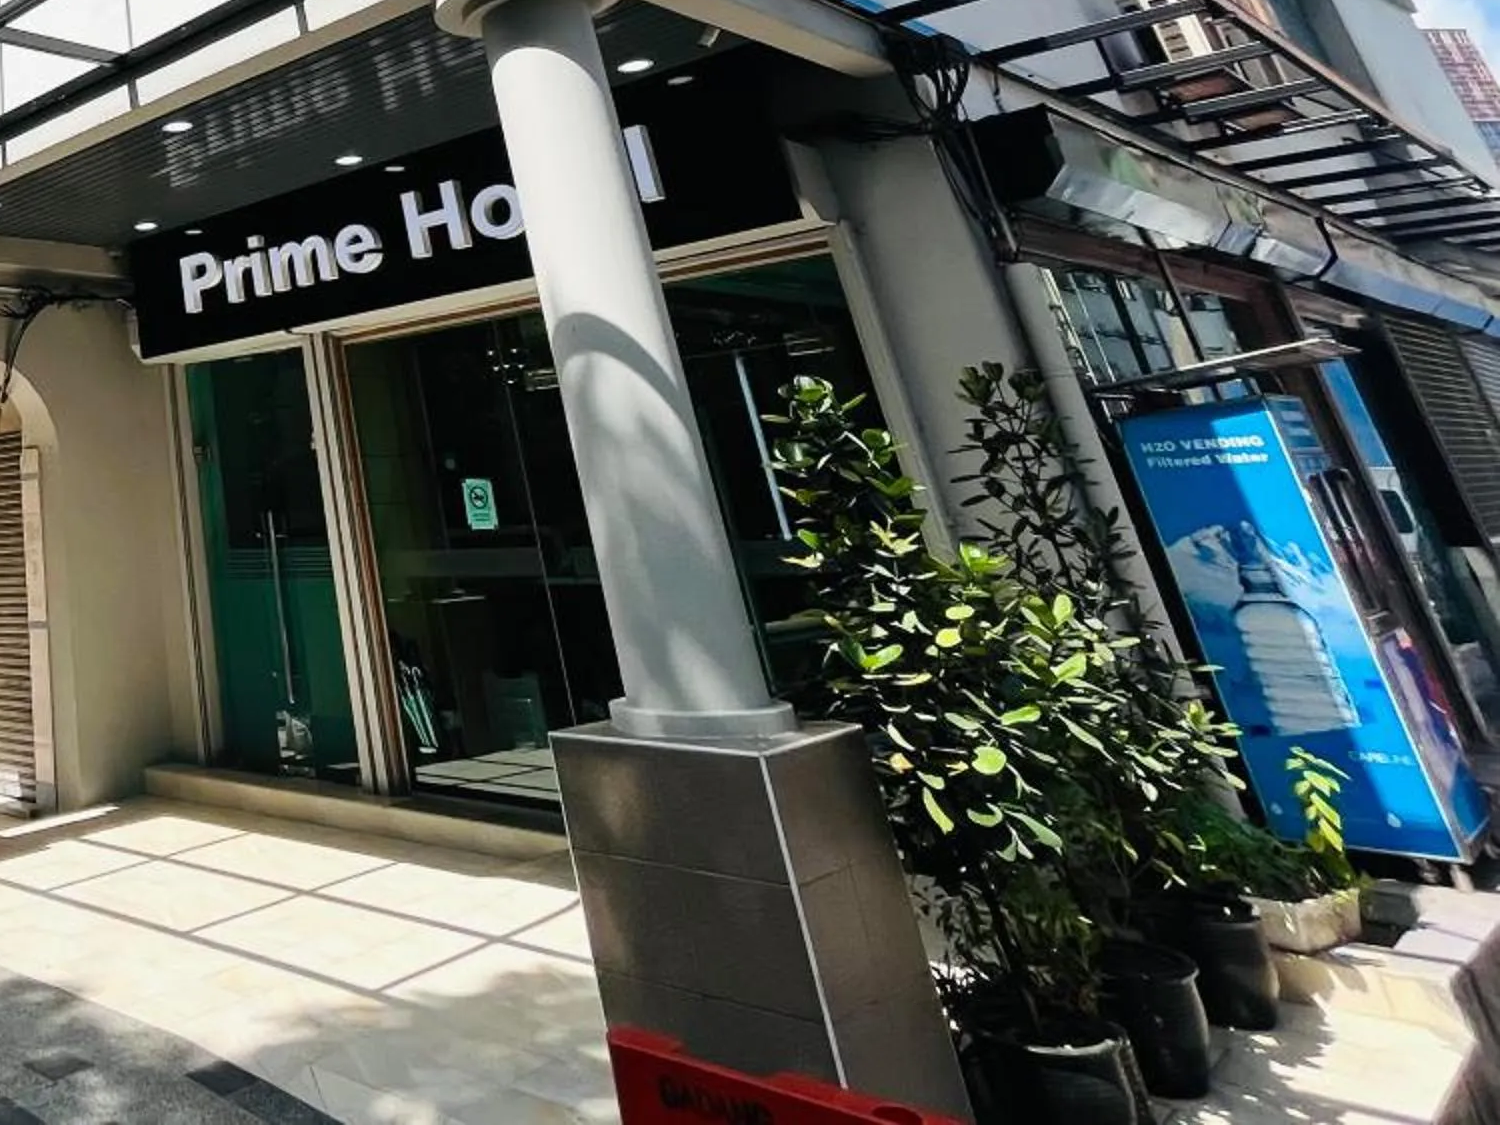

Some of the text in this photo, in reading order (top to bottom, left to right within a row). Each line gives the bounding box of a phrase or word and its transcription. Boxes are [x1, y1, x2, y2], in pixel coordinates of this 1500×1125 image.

[179, 223, 385, 314] Prime
[400, 124, 665, 259] Hol
[1180, 434, 1265, 451] VENDING
